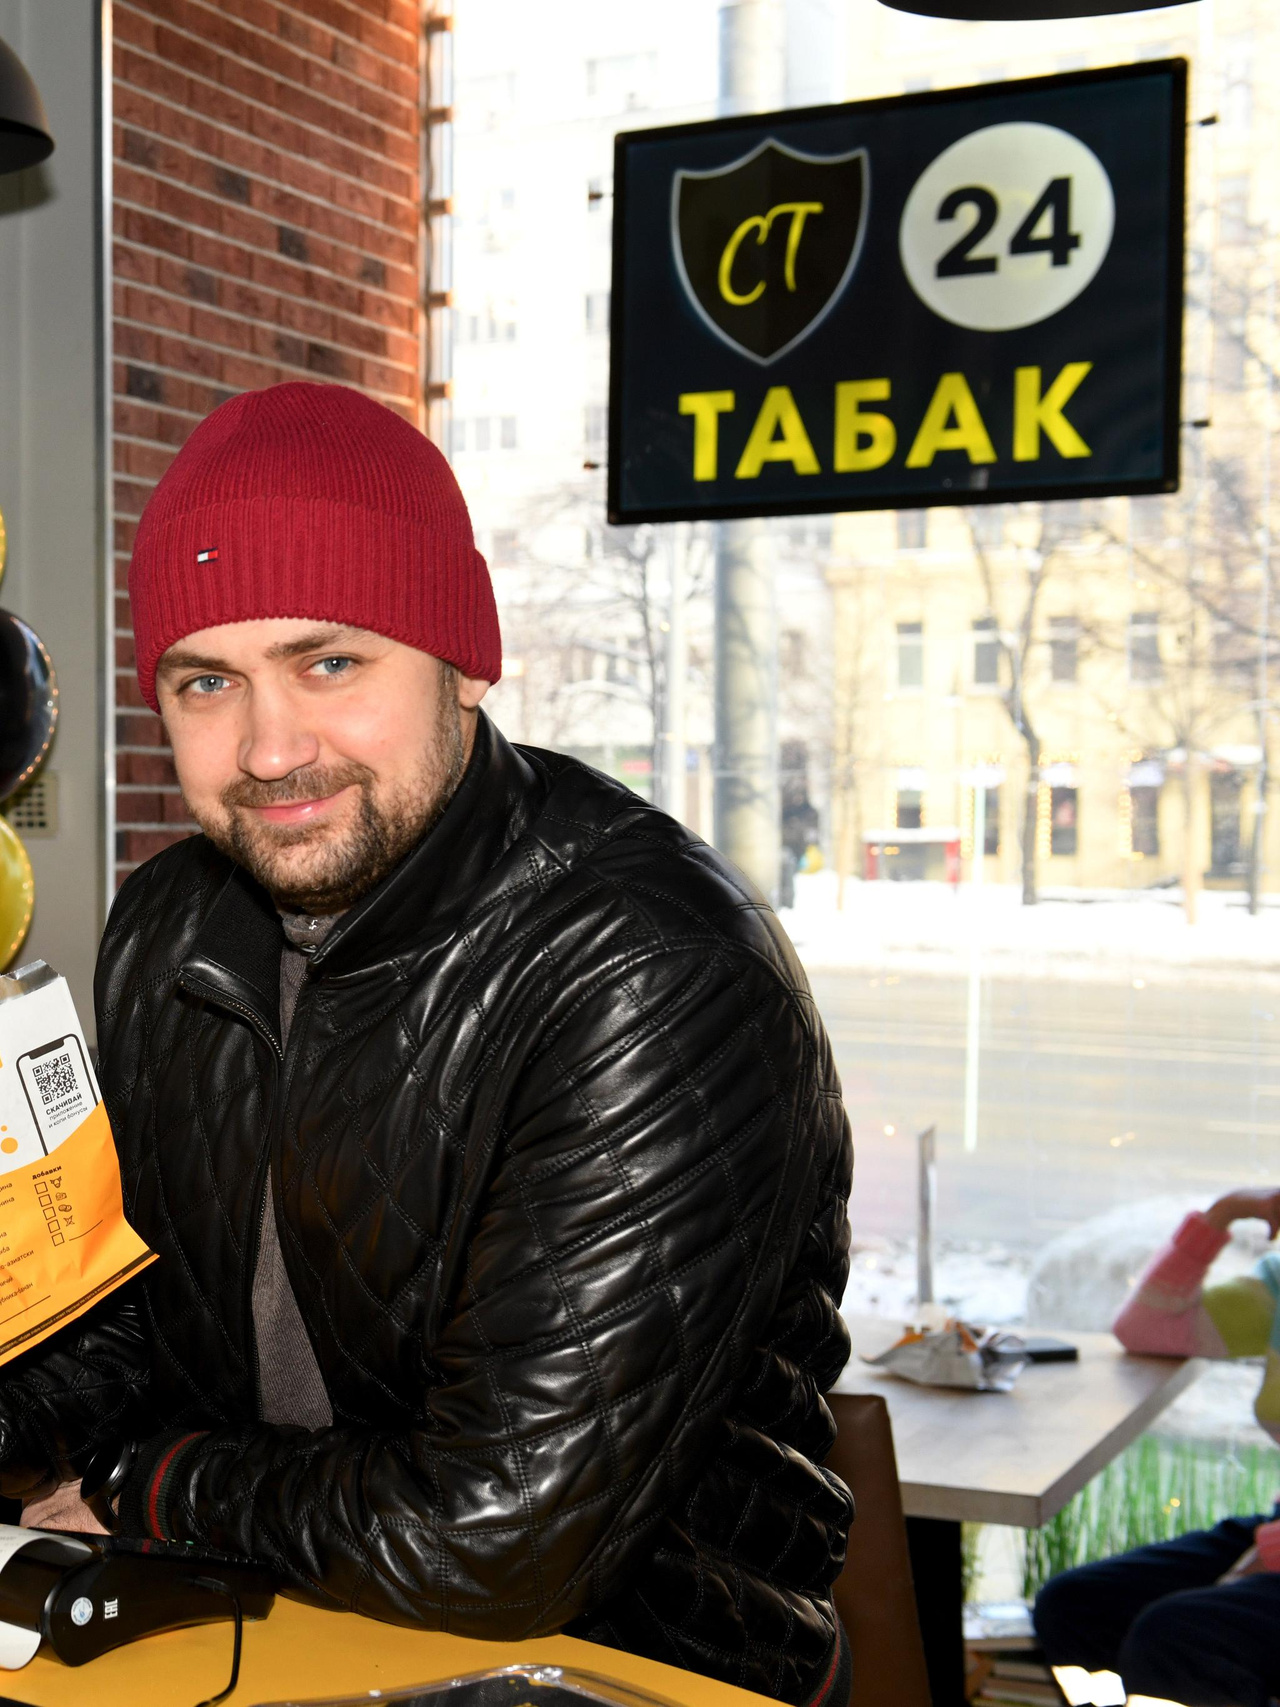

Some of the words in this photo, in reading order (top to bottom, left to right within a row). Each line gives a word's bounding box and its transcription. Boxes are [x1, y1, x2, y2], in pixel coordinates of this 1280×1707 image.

[935, 176, 1081, 279] 24
[678, 361, 1093, 482] ТАБАК
[45, 1093, 82, 1115] СКАЧИВАЙ
[49, 1102, 83, 1121] приложение
[67, 1107, 88, 1120] бонусы
[32, 1165, 62, 1180] добавки
